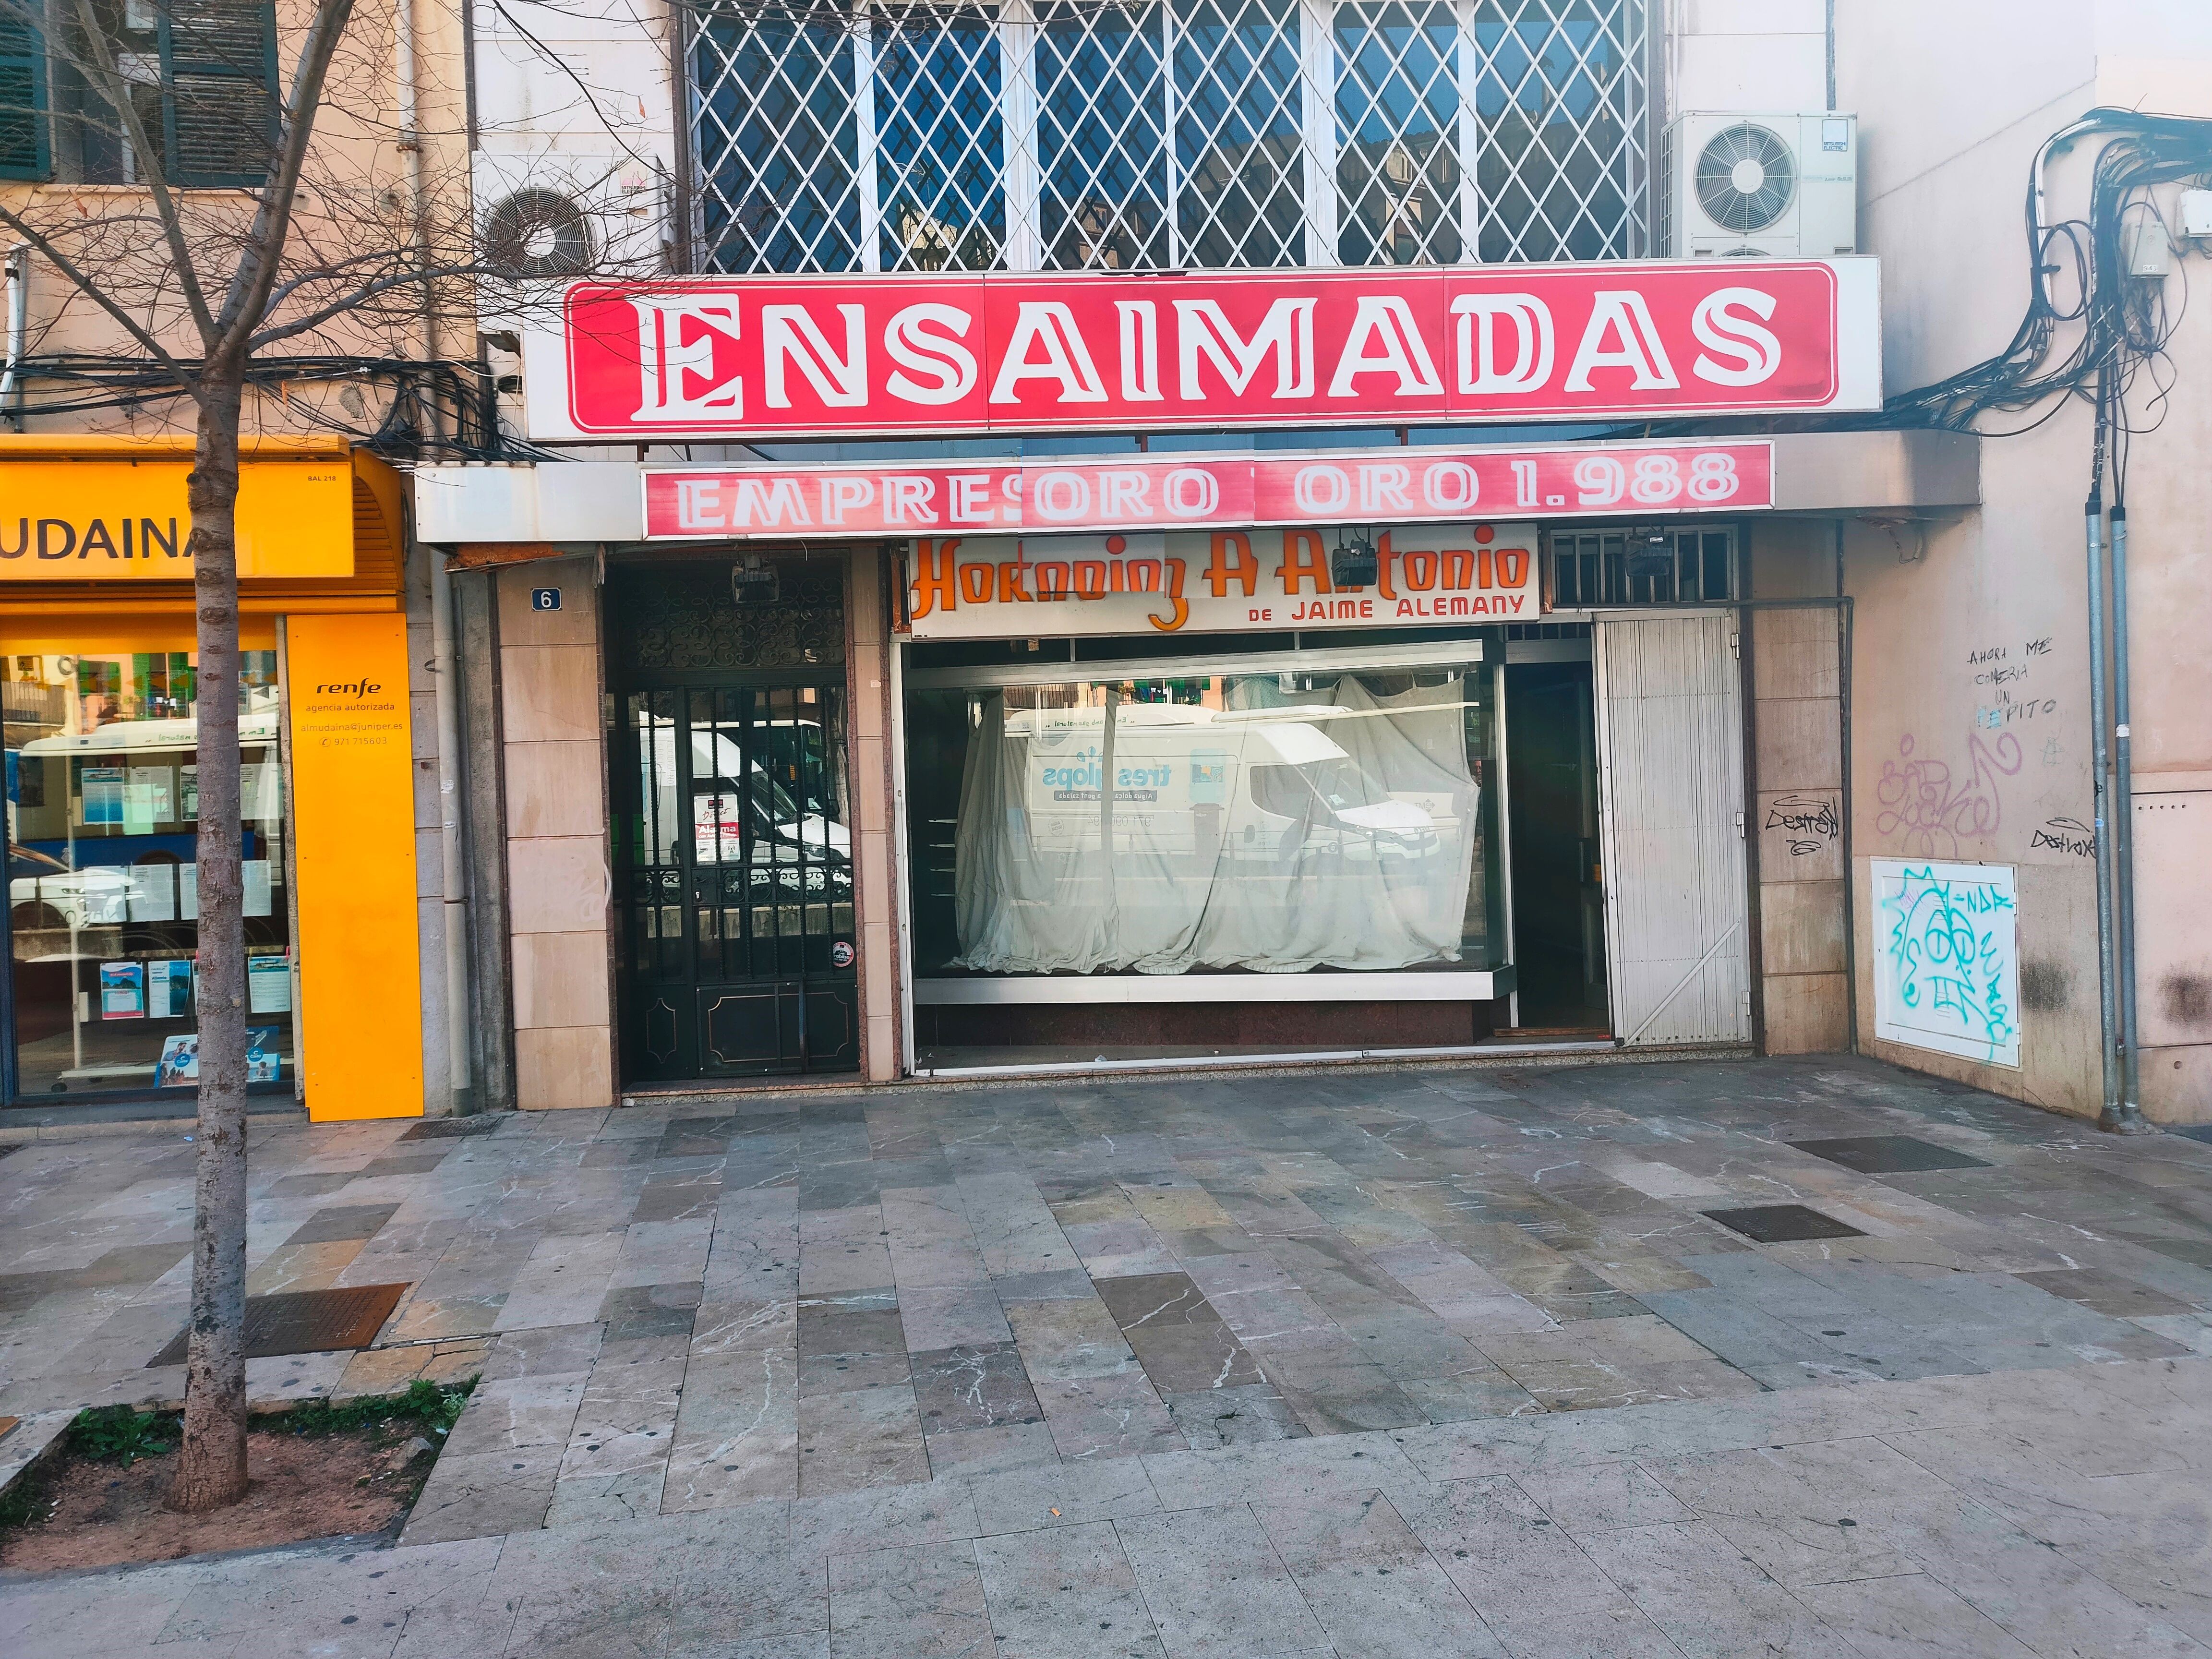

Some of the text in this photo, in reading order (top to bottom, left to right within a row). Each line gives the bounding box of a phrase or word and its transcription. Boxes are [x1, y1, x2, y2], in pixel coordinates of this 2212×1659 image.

[630, 287, 1782, 421] ENSAIMADAS
[1294, 461, 1480, 514] ORO
[1510, 452, 1740, 508] 1.988
[0, 517, 193, 560] UDAIN
[1274, 525, 1529, 601] Atonio
[541, 591, 552, 608] 6
[1249, 595, 1525, 622] DE JAIME ALEMANY
[1967, 637, 2052, 665] AHORA ME
[316, 677, 382, 699] renfe
[1996, 689, 2010, 706] UN
[306, 702, 395, 713] agencia autorizada
[301, 723, 403, 733] almudaina@juniper.es
[353, 737, 387, 745] 715603
[698, 825, 736, 834] Alama
